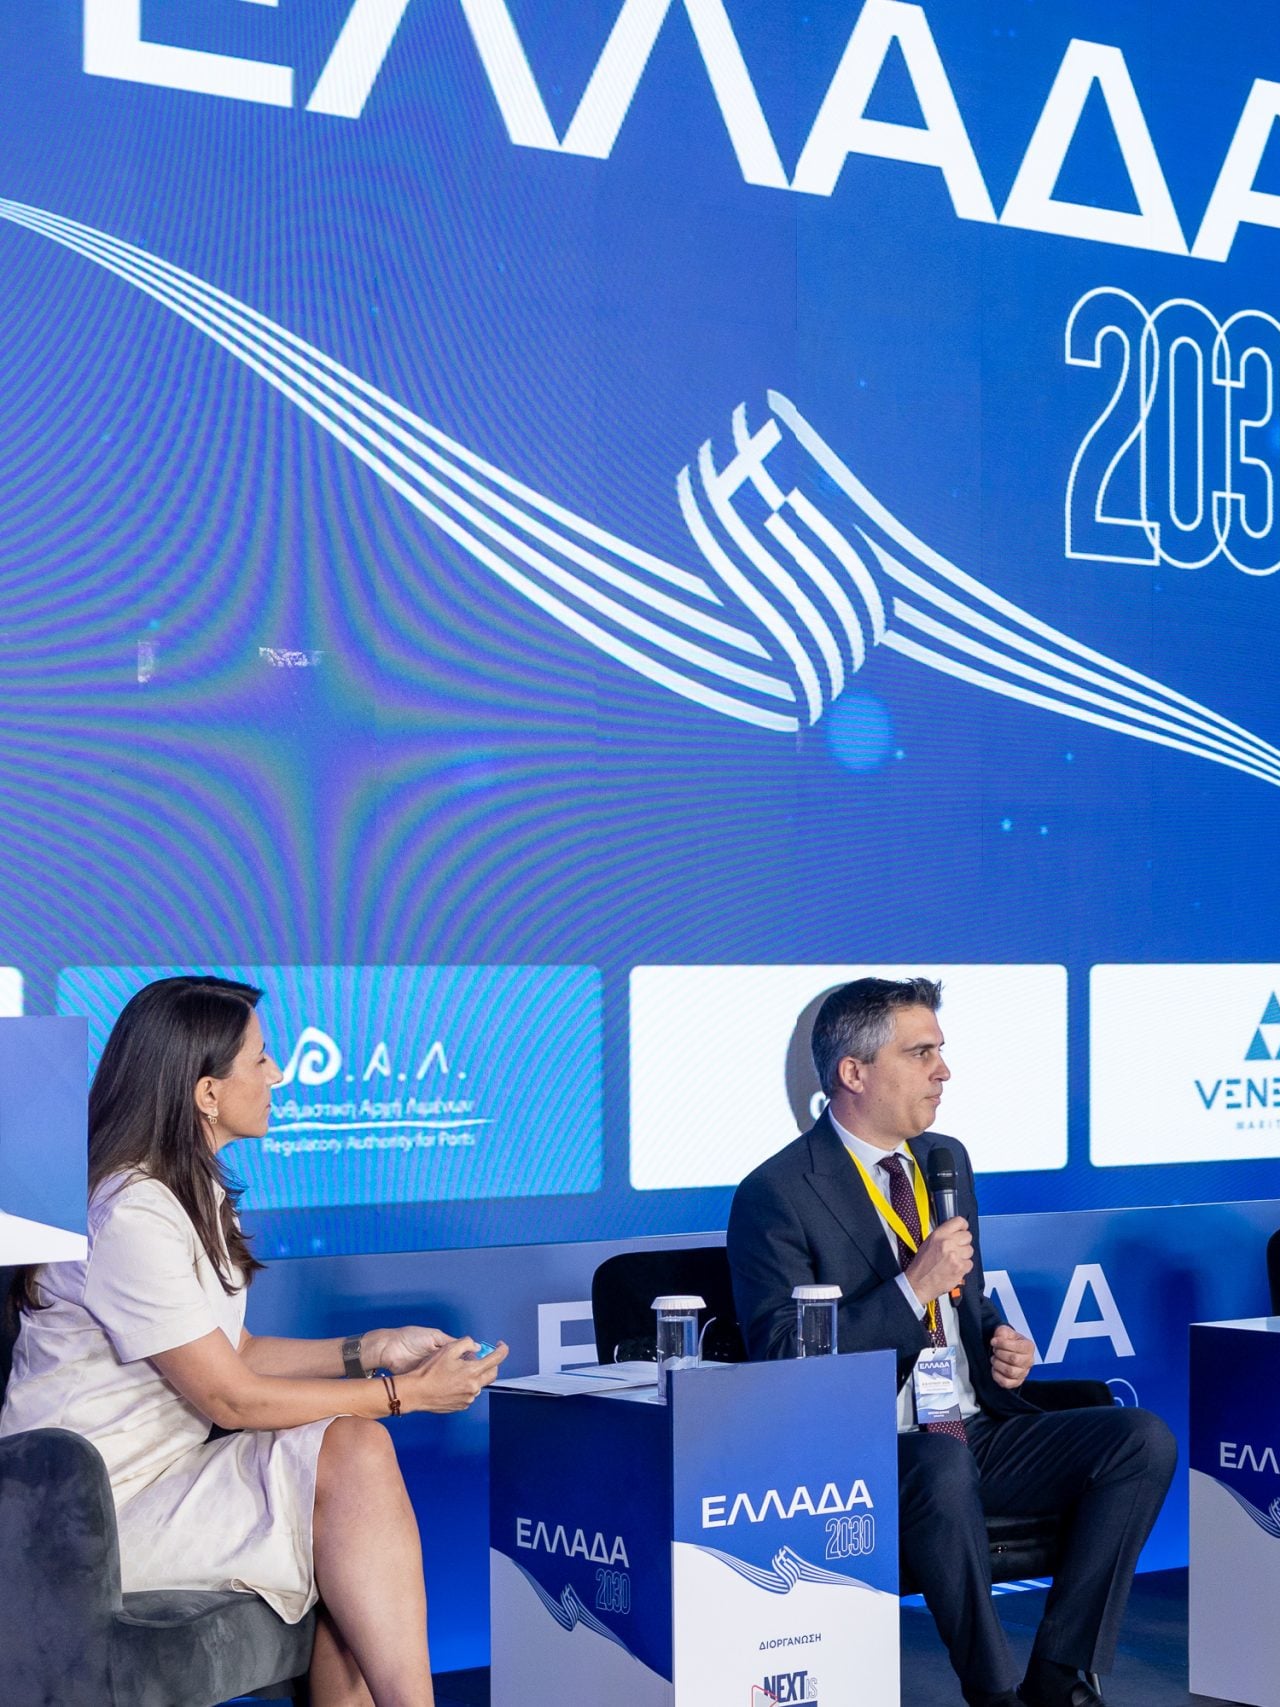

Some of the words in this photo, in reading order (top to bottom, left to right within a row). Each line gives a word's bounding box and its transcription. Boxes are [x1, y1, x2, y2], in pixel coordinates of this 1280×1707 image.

[702, 1479, 874, 1528] ΕΛΛΑΔΑ
[516, 1517, 629, 1568] ΕΛΛΑΔΑ
[825, 1513, 875, 1560] 2030
[595, 1568, 631, 1614] 2030
[759, 1632, 822, 1650] ΔΙΟΡΓΑΝΩΣΗ
[763, 1670, 808, 1703] NEXT
